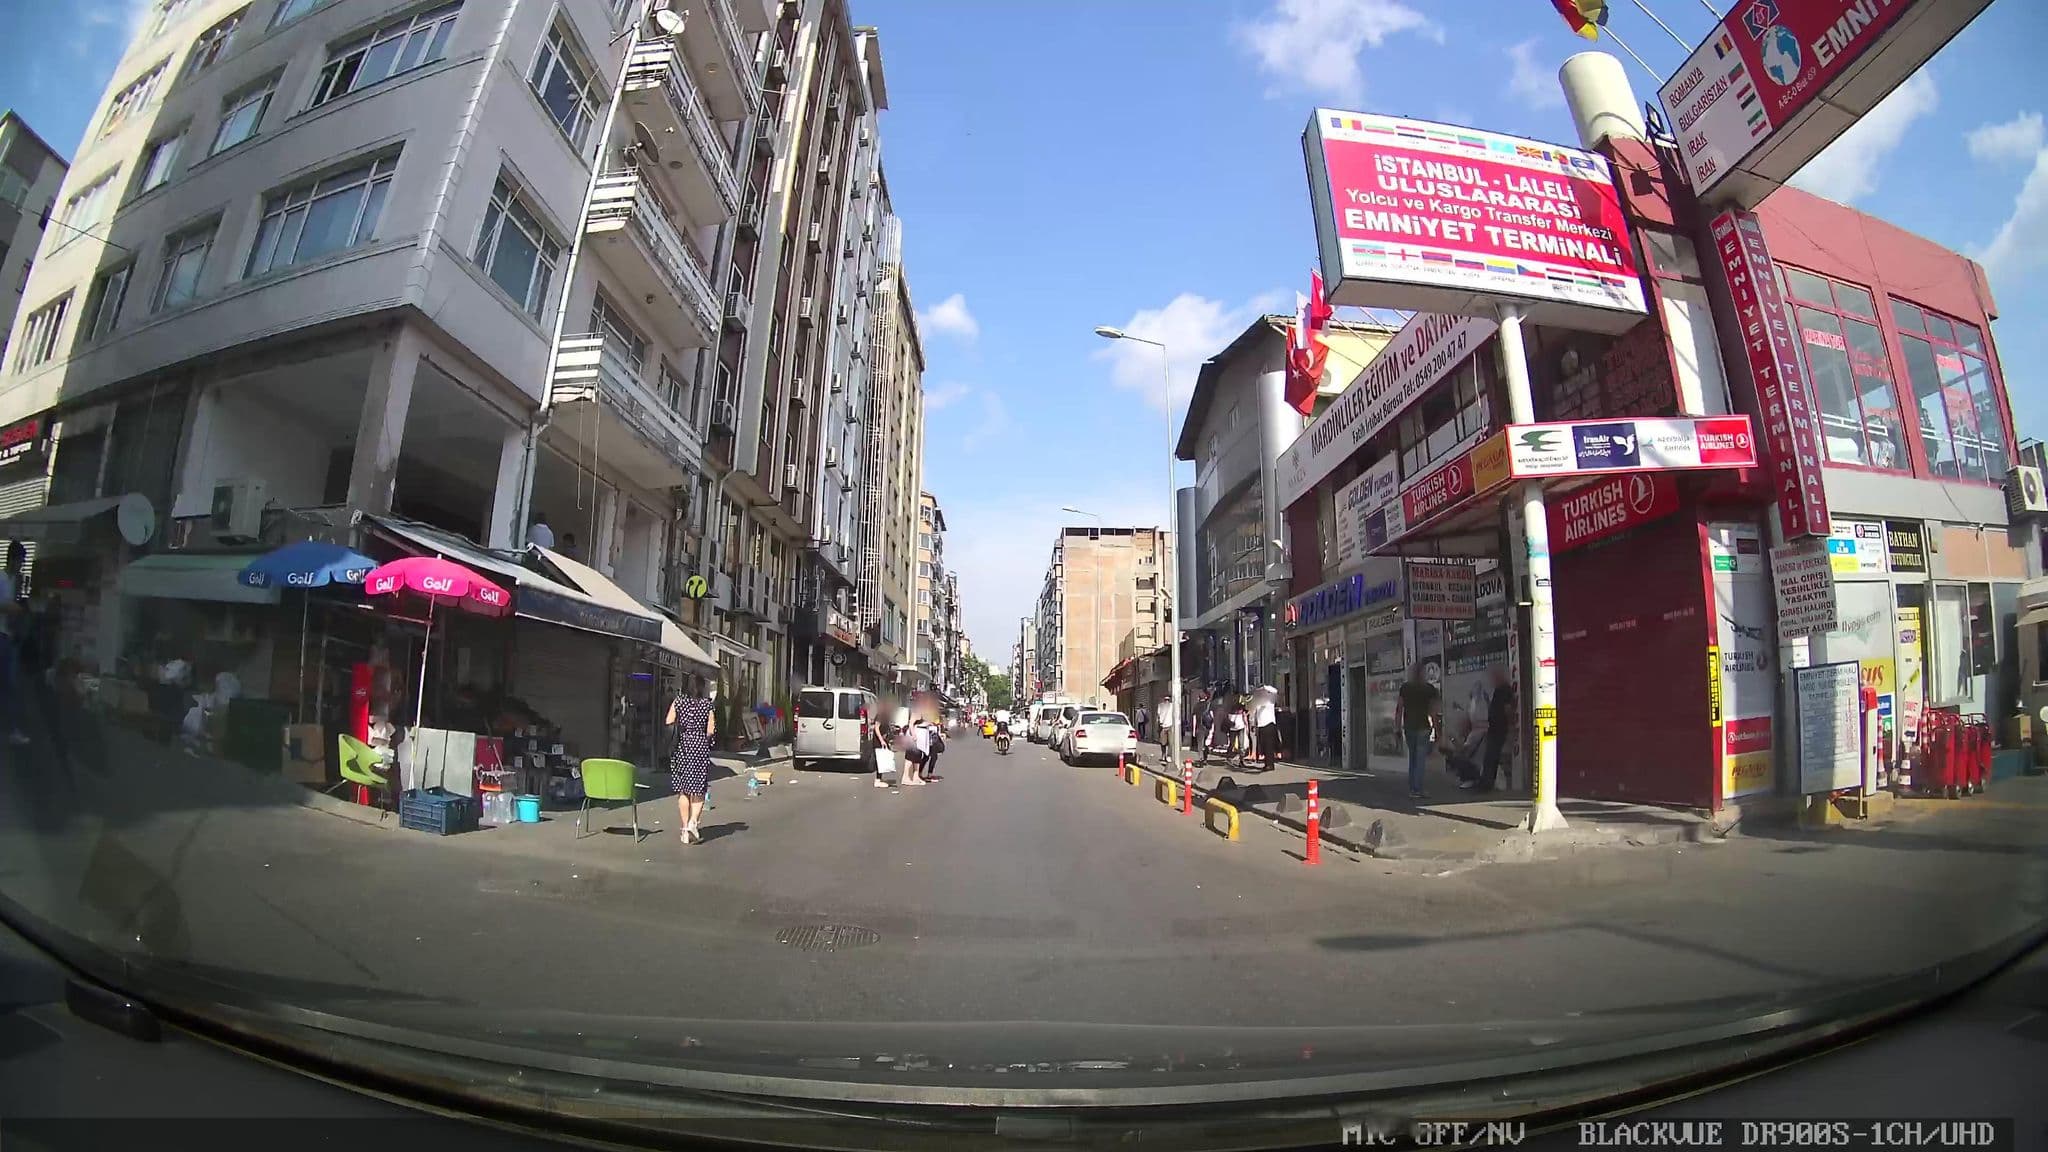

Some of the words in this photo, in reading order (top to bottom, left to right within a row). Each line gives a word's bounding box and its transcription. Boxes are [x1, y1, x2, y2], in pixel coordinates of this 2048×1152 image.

[1669, 66, 1705, 108] ROMANYA
[1687, 131, 1708, 156] IRAK
[1376, 175, 1582, 220] ULUSLARARASI
[1345, 188, 1399, 209] Yolcu
[1403, 198, 1424, 210] ve
[1429, 199, 1482, 220] Kargo
[1485, 206, 1552, 230] Transfer
[1555, 221, 1613, 242] Merkezi
[1401, 343, 1416, 373] ve
[1402, 377, 1416, 400] Tel:
[1415, 362, 1432, 389] 0549
[1432, 350, 1447, 375] 200
[1457, 330, 1467, 351] 47
[1699, 433, 1734, 442] TURKISH
[1700, 441, 1735, 450] AIRLINES
[1411, 472, 1446, 504] TURKISH
[1413, 487, 1448, 519] AIRLINES
[1562, 479, 1624, 521] TURKISH
[1565, 502, 1627, 544] AIRLINES
[287, 571, 314, 586] Golf
[376, 576, 394, 591] Golf
[423, 576, 453, 592] Golf
[480, 587, 499, 603] Golf
